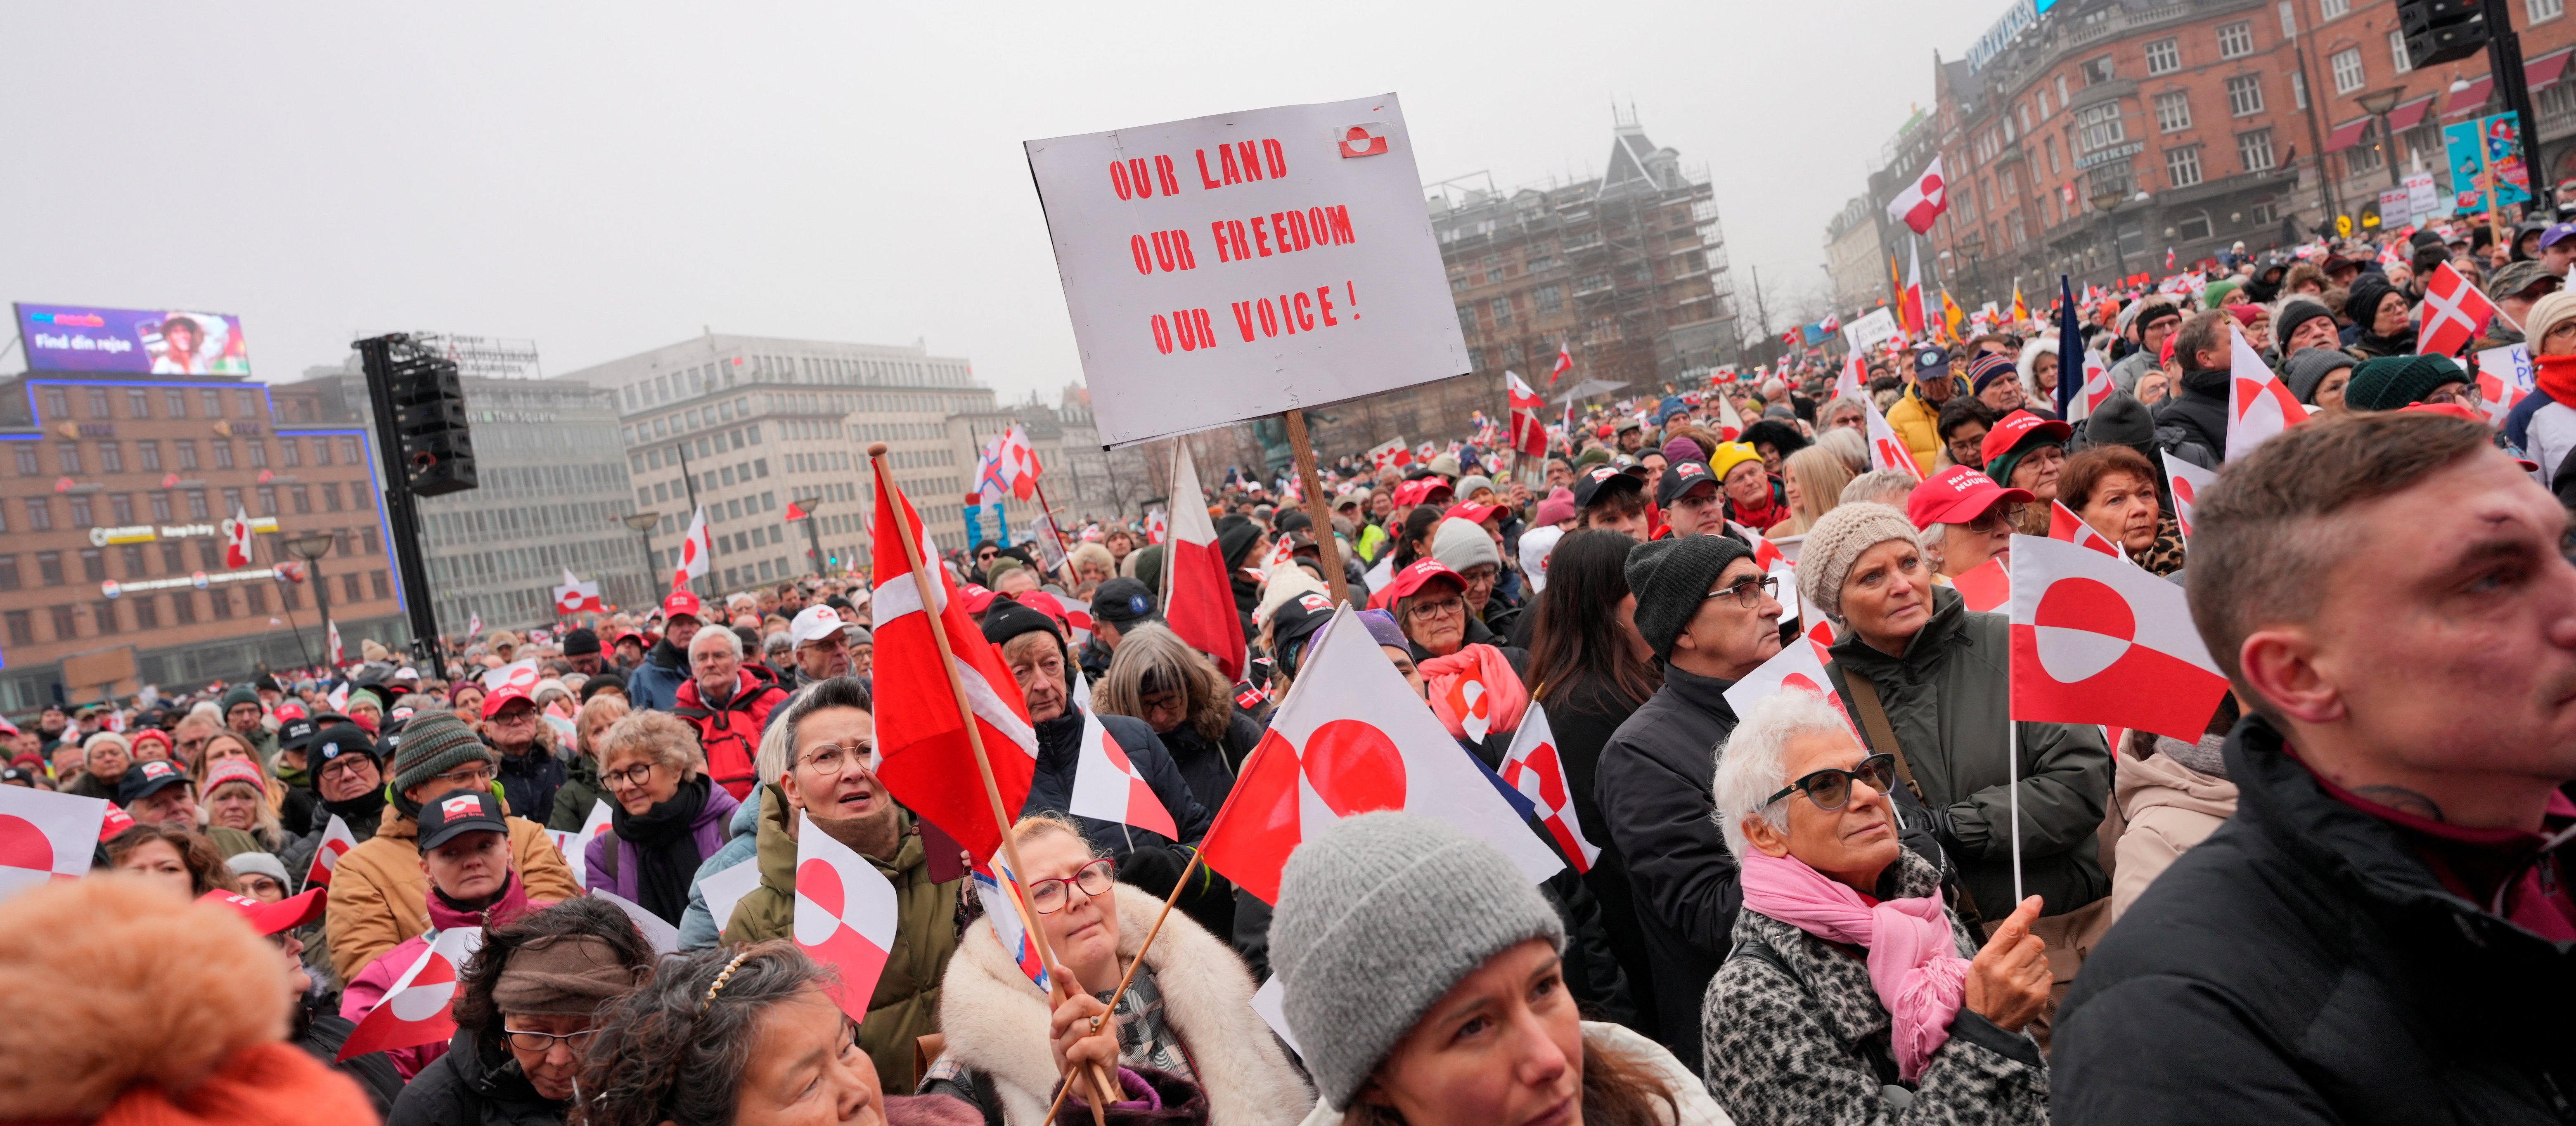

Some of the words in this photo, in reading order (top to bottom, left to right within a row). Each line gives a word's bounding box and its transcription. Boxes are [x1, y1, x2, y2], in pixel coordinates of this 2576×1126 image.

[1965, 0, 2037, 78] POLITIKEN
[1109, 154, 1180, 201] OUR
[1195, 138, 1287, 190] LAND
[1131, 229, 1196, 276] OUR
[1211, 204, 1356, 263] FREEDOM
[1151, 308, 1217, 355] OUR
[35, 333, 70, 349] Find
[70, 334, 97, 350] din
[96, 336, 132, 354] rejse
[493, 410, 515, 424] The
[518, 410, 556, 424] Square
[2006, 418, 2022, 429] MAKE
[1947, 474, 1965, 485] Nu
[1955, 478, 1989, 492] NUUK!
[1415, 562, 1427, 570] Nu
[1417, 565, 1445, 575] NUUK!
[1307, 606, 1326, 615] Already
[444, 813, 467, 823] Already
